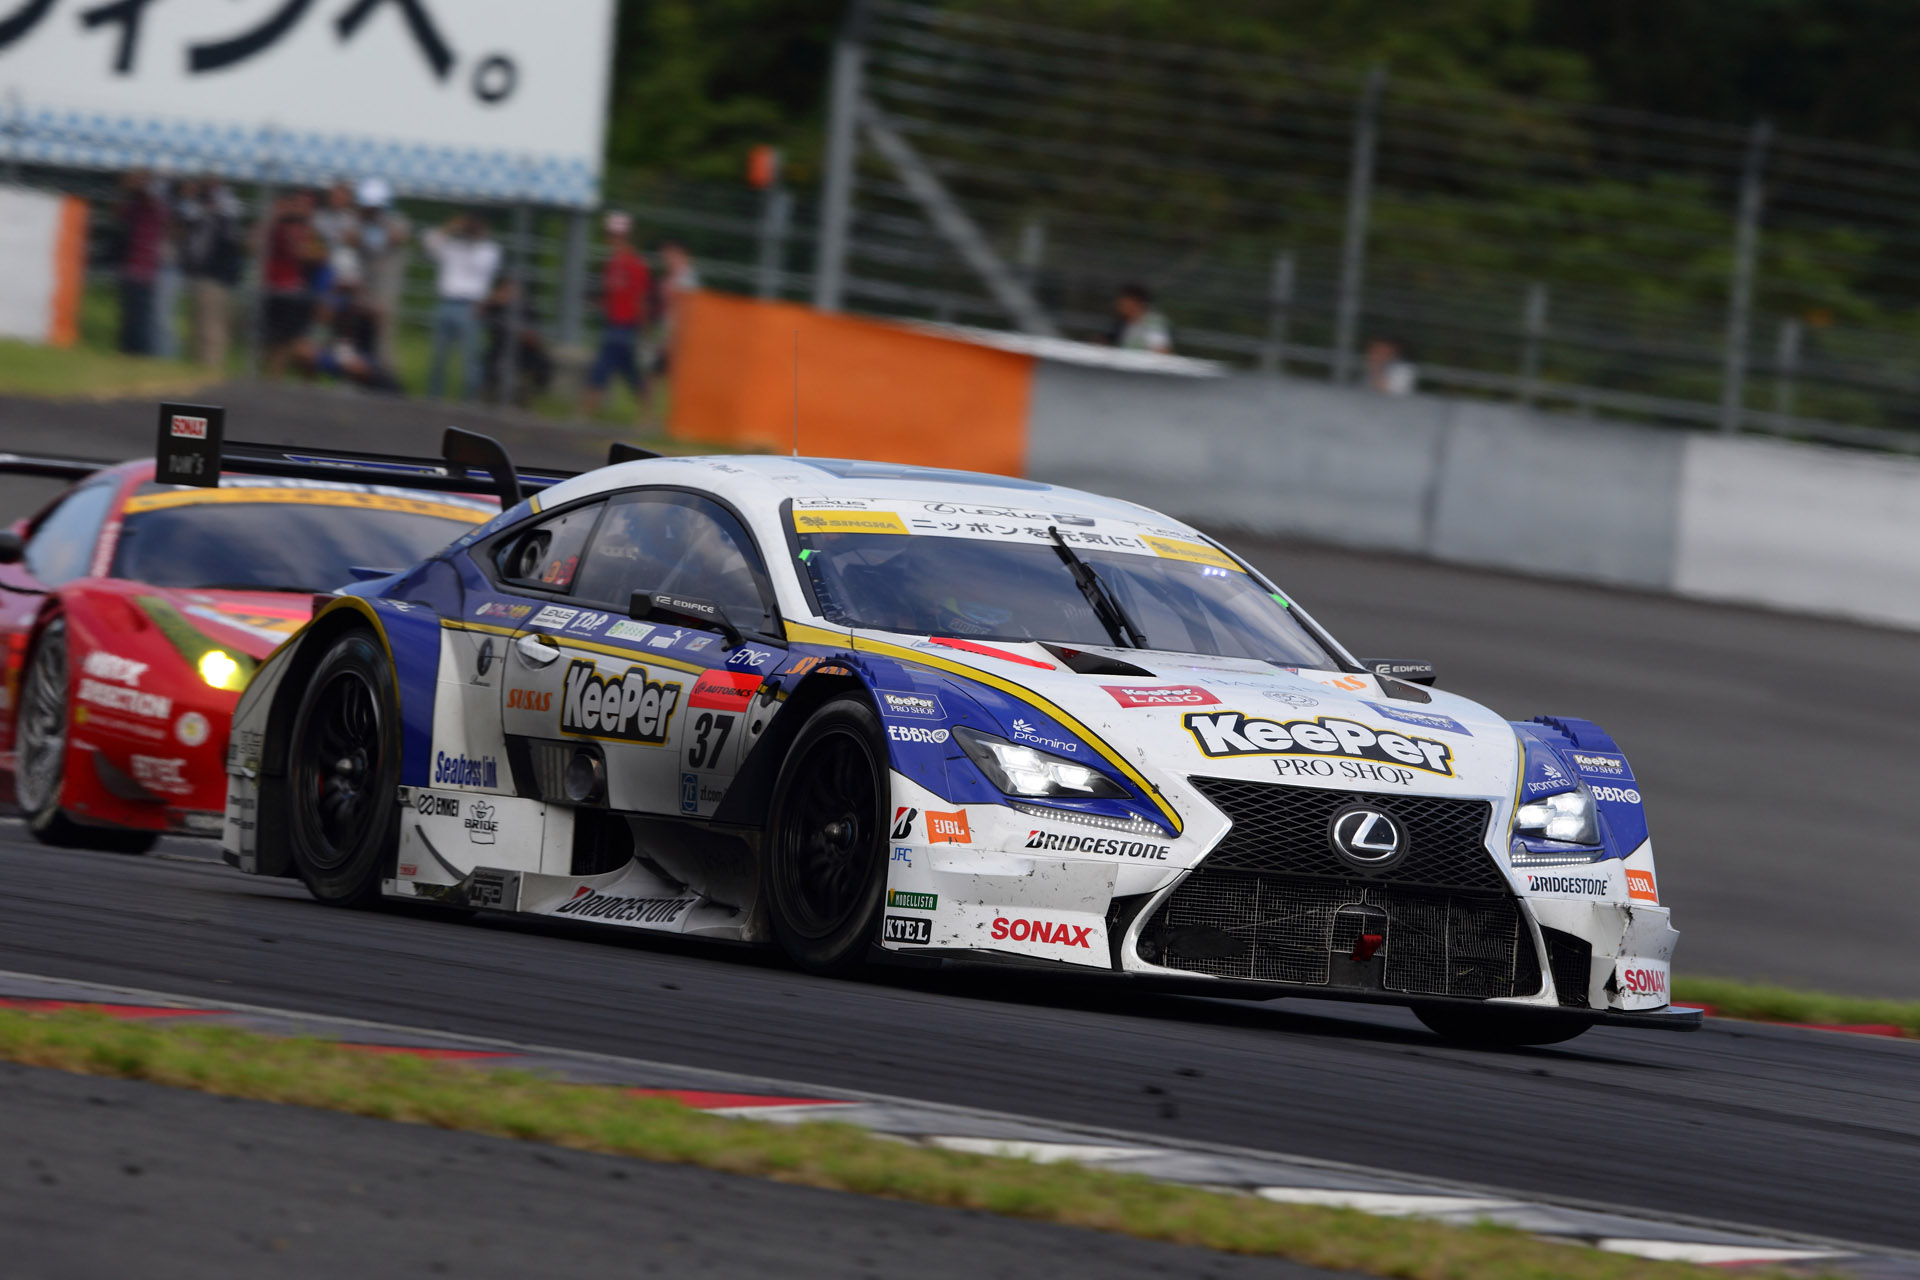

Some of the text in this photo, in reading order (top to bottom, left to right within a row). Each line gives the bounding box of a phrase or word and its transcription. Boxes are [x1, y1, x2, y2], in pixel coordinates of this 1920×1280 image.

[960, 507, 1051, 521] LEXUS
[672, 599, 715, 614] EDIFICE
[1392, 665, 1432, 673] EDIFICE
[562, 660, 681, 738] KeePer
[705, 685, 752, 698] AUTOBACS
[1122, 687, 1192, 696] KeePer
[1129, 694, 1203, 703] LABO
[506, 689, 553, 712] SUSAS
[884, 695, 933, 708] KeePer
[890, 704, 936, 715] PRO SHOP
[688, 712, 735, 769] 37
[888, 725, 950, 744] EBBRO
[1013, 730, 1078, 752] promina
[1191, 713, 1450, 772] KeePer
[435, 751, 481, 786] Seabass
[1574, 754, 1621, 767] KeePer
[1272, 759, 1414, 786] PRO SHOP
[1579, 764, 1624, 775] PRO SHOP
[1527, 779, 1570, 794] promina
[436, 798, 460, 818] ENKEI
[464, 818, 499, 832] BRIDE
[935, 819, 965, 836] JBL
[1024, 830, 1171, 861] BRIDGESTONE
[891, 848, 912, 862] JFC
[1529, 875, 1608, 896] BRIDGESTONE
[1629, 877, 1654, 894] JBL
[557, 886, 696, 923] BRIDGESTONE
[895, 894, 934, 908] MODELLISTA
[885, 918, 929, 941] KTEL
[991, 917, 1093, 949] SONAX
[1625, 969, 1666, 994] SONAX
